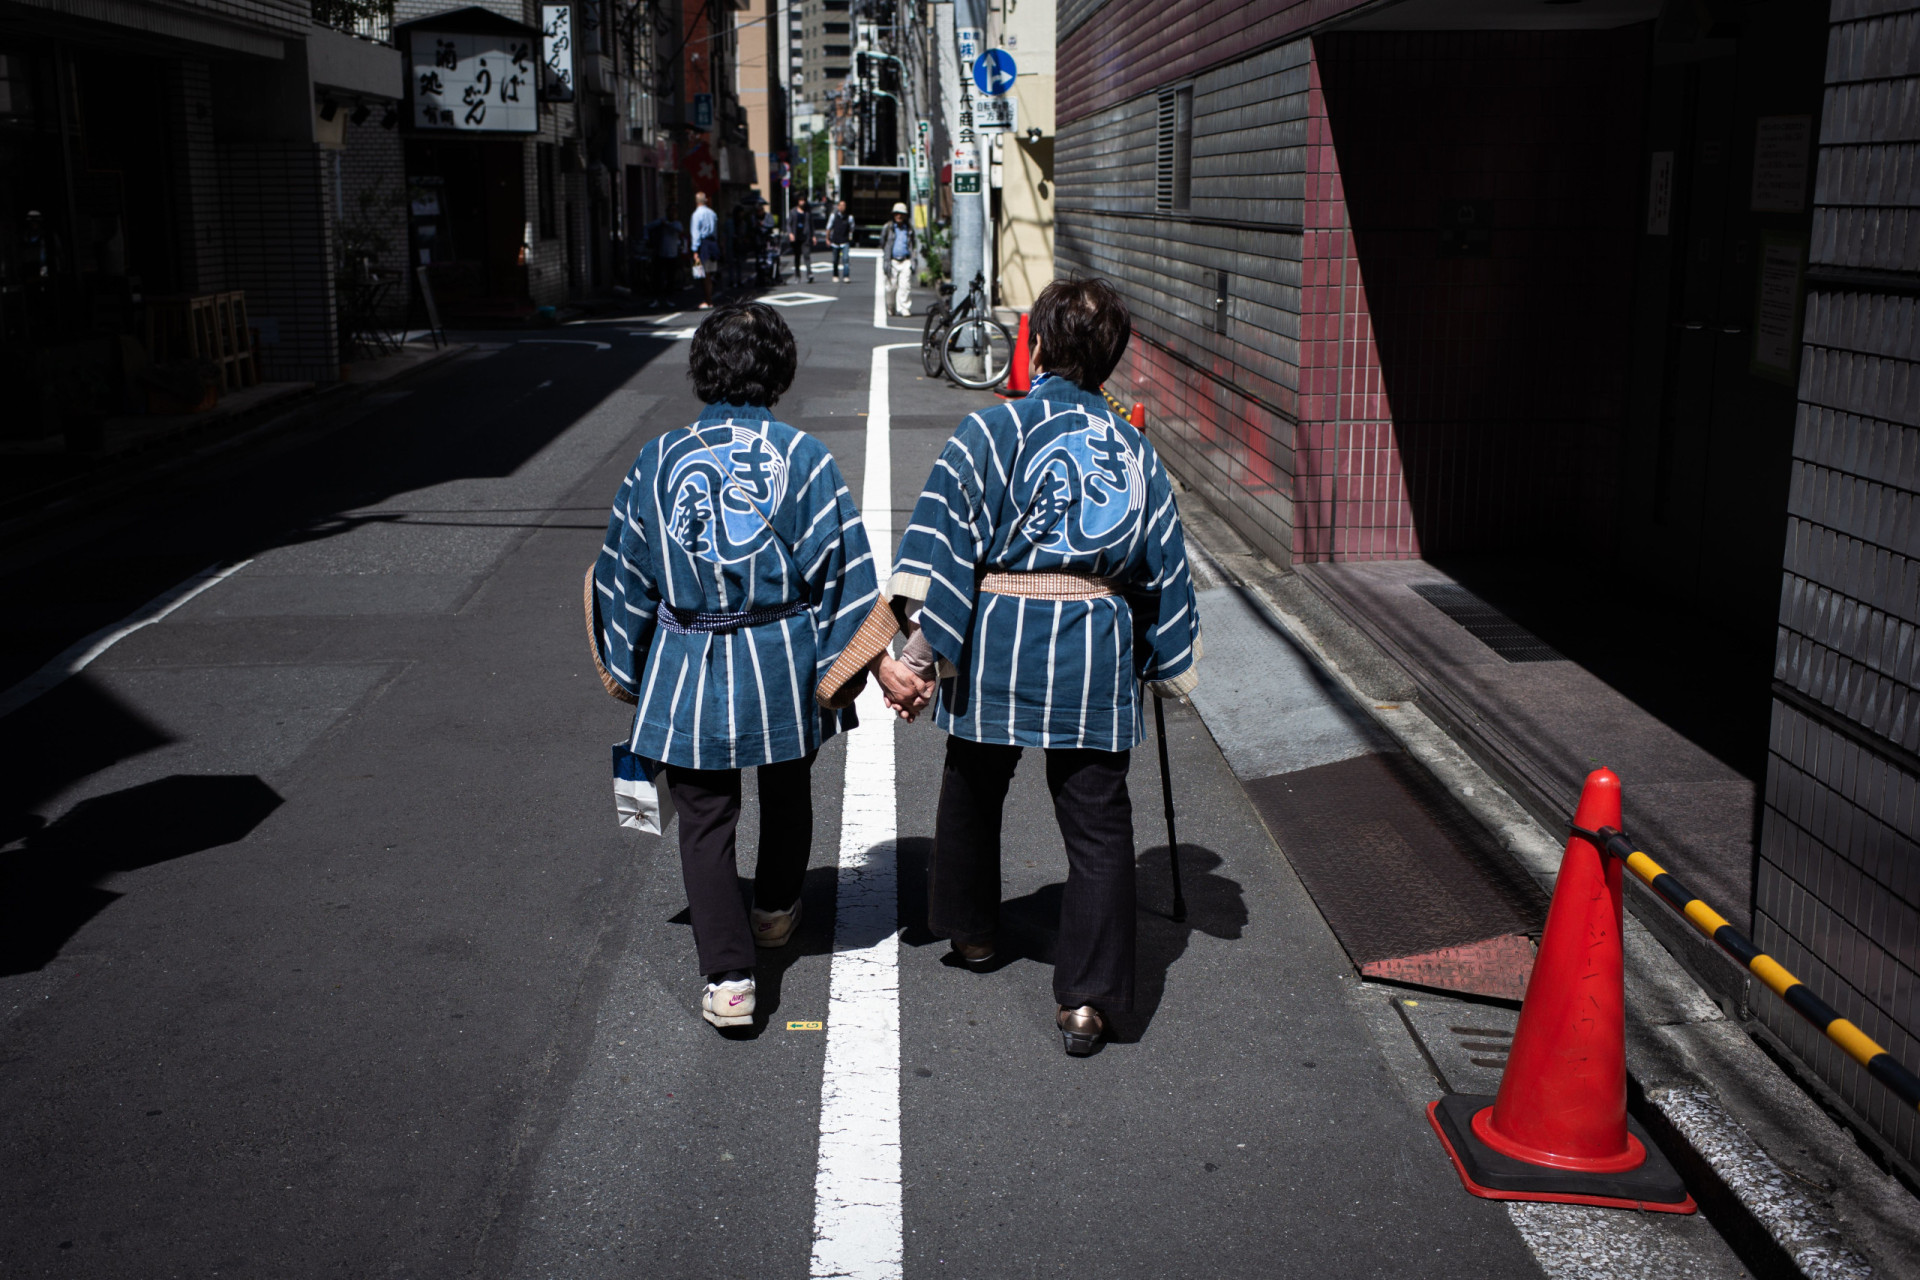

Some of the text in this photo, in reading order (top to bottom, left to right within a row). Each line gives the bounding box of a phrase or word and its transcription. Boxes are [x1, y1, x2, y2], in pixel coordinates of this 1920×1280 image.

[462, 58, 492, 125] うどん
[500, 42, 529, 104] そば
